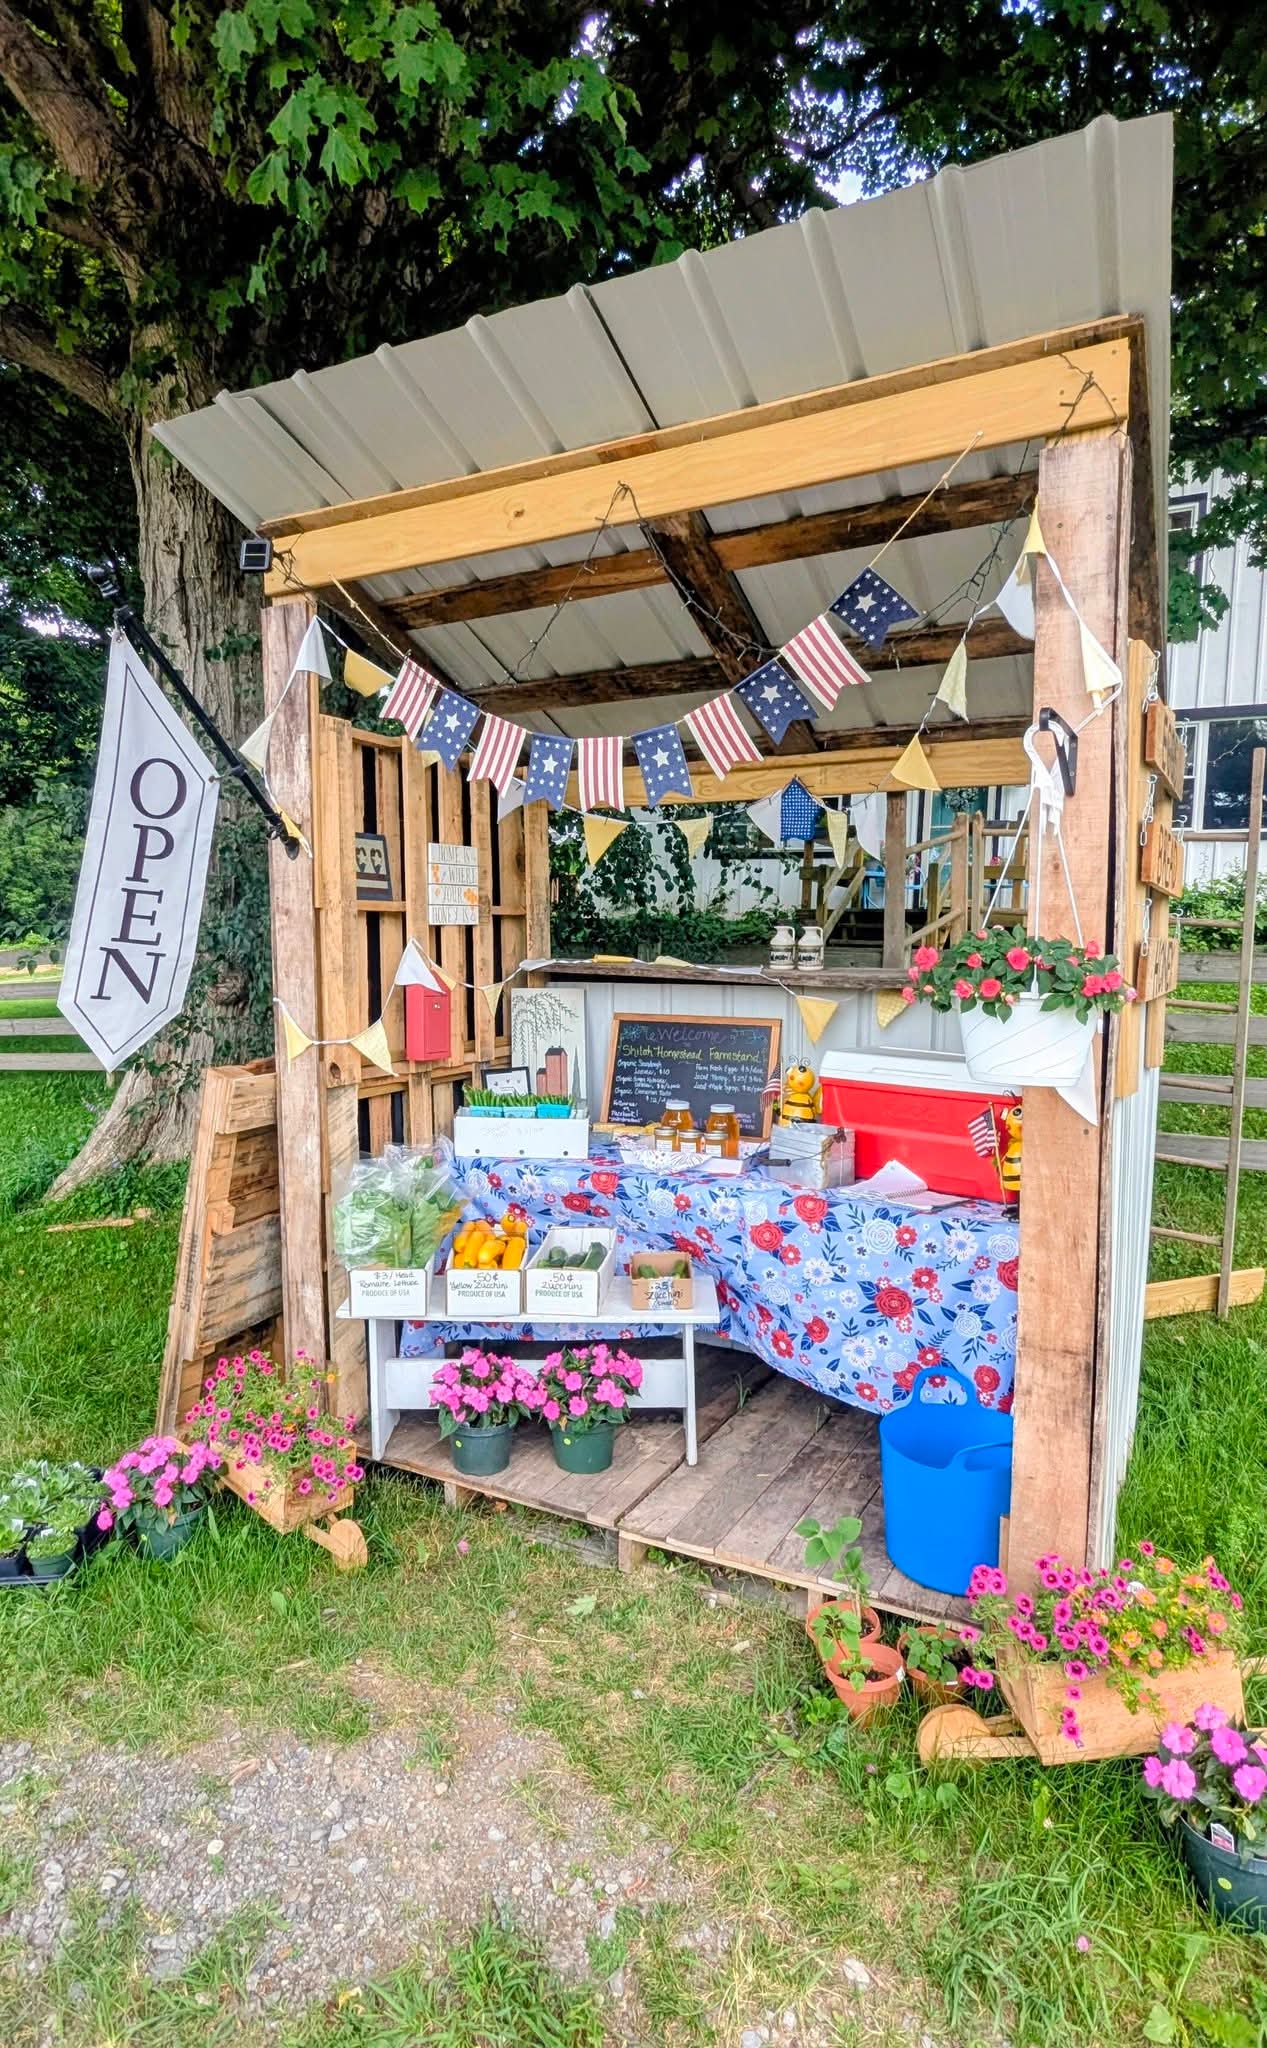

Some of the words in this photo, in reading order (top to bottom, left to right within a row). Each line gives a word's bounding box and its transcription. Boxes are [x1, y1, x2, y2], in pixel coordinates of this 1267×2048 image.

[448, 866, 475, 884] WHERE
[89, 757, 187, 1005] OPEN
[657, 1025, 726, 1044] Welcome
[654, 1045, 703, 1061] Homestead
[359, 1280, 391, 1288] Romaine
[450, 1281, 473, 1291] Yellow
[474, 1280, 508, 1289] Zucchini
[541, 1281, 583, 1290] Zucchini
[361, 1289, 389, 1297] PRODUCE
[494, 1290, 506, 1298] USA
[535, 1289, 562, 1298] PRODUCE
[563, 1290, 570, 1298] OF
